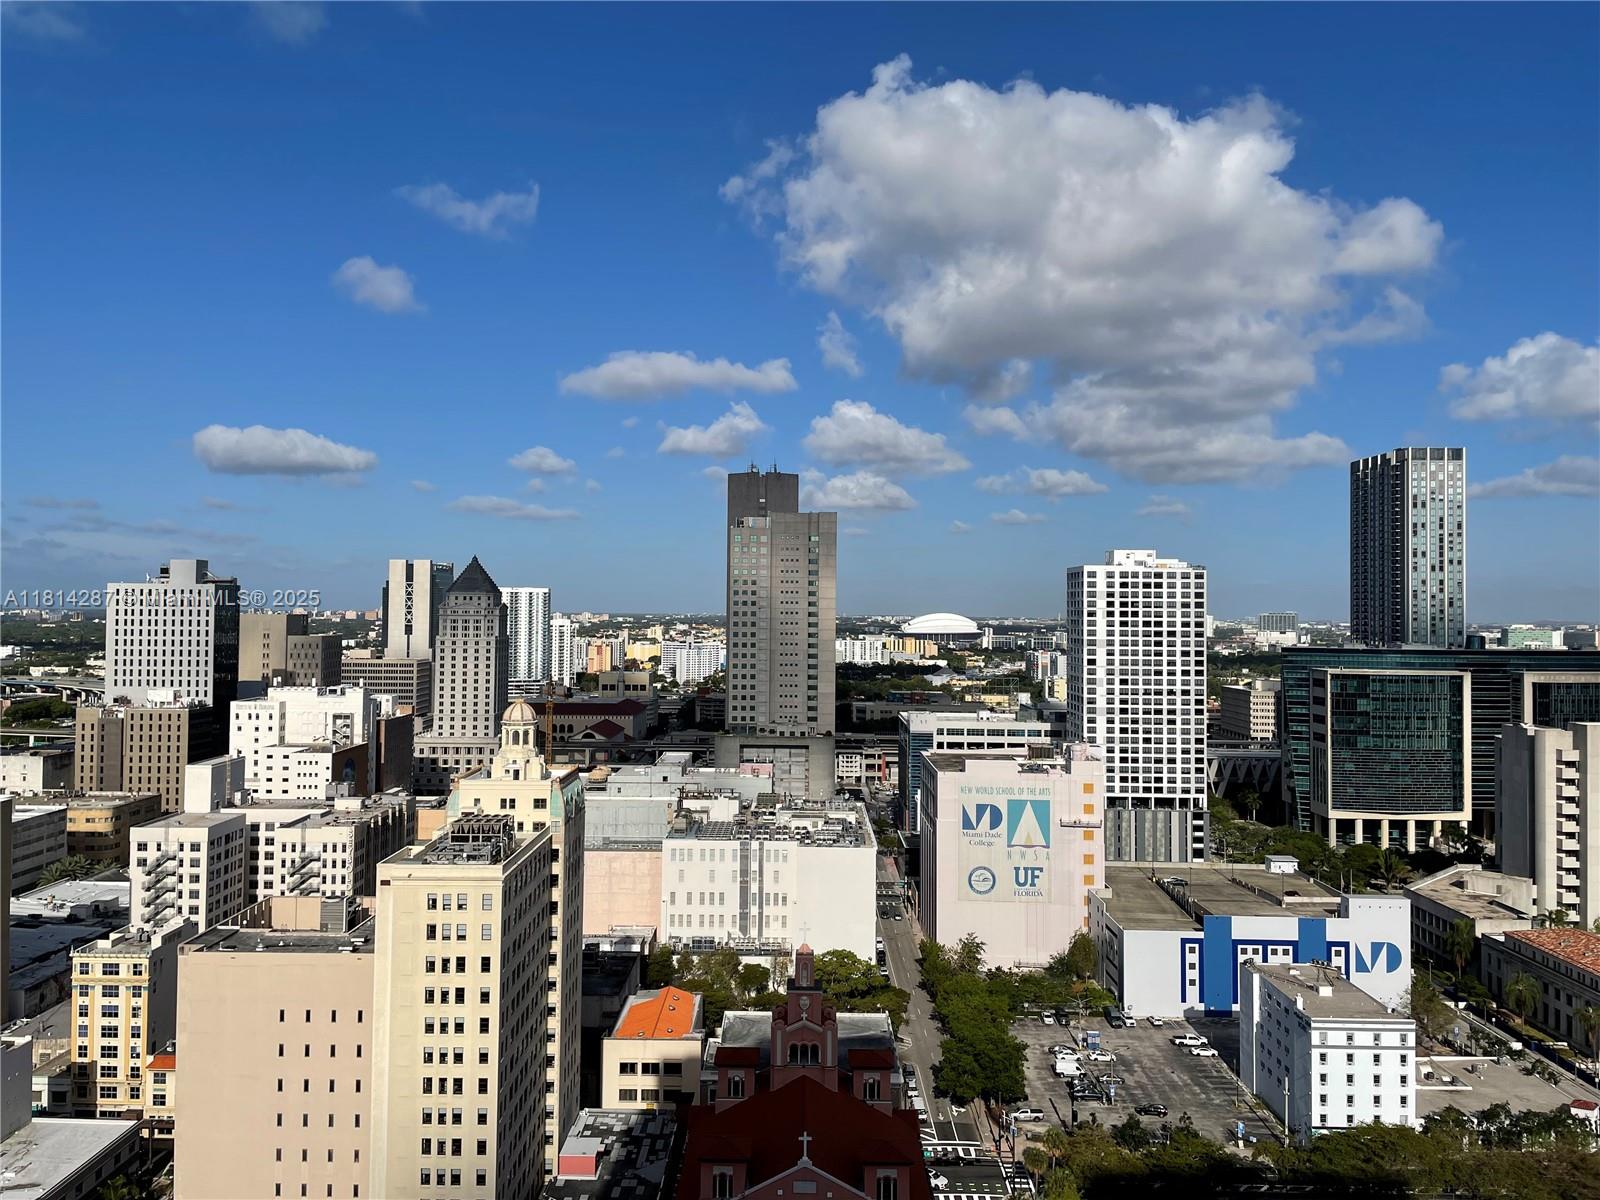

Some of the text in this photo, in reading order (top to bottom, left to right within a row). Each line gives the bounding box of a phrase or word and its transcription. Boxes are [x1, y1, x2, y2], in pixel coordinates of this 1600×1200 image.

[960, 786, 1051, 796] NEW WORLD SCHOOL OF THE ARTS
[969, 839, 996, 848] College
[1013, 866, 1044, 887] UF
[1013, 889, 1044, 897] FLORIDA
